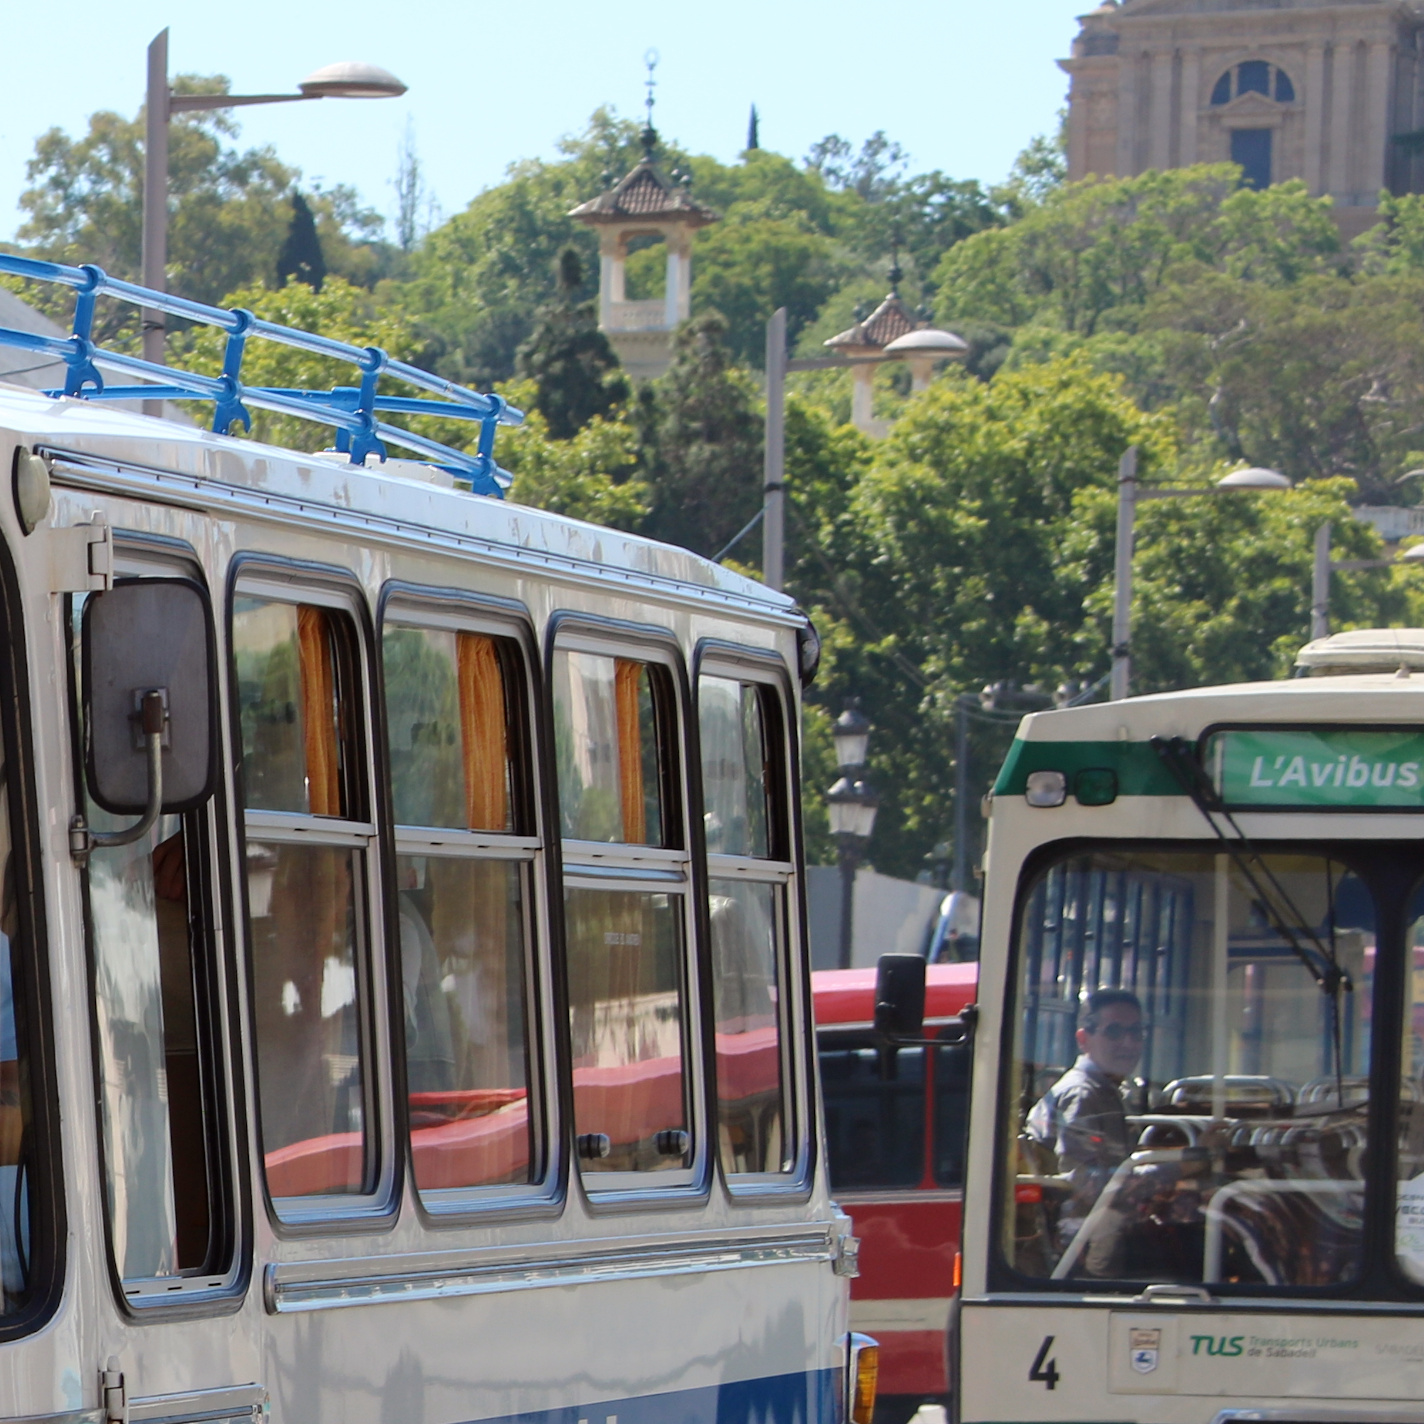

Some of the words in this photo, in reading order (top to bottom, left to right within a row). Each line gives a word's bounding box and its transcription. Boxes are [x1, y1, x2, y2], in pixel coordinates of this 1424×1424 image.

[1249, 755, 1419, 787] L'Avibus
[1190, 1335, 1245, 1357] TUS
[1028, 1335, 1059, 1390] 4
